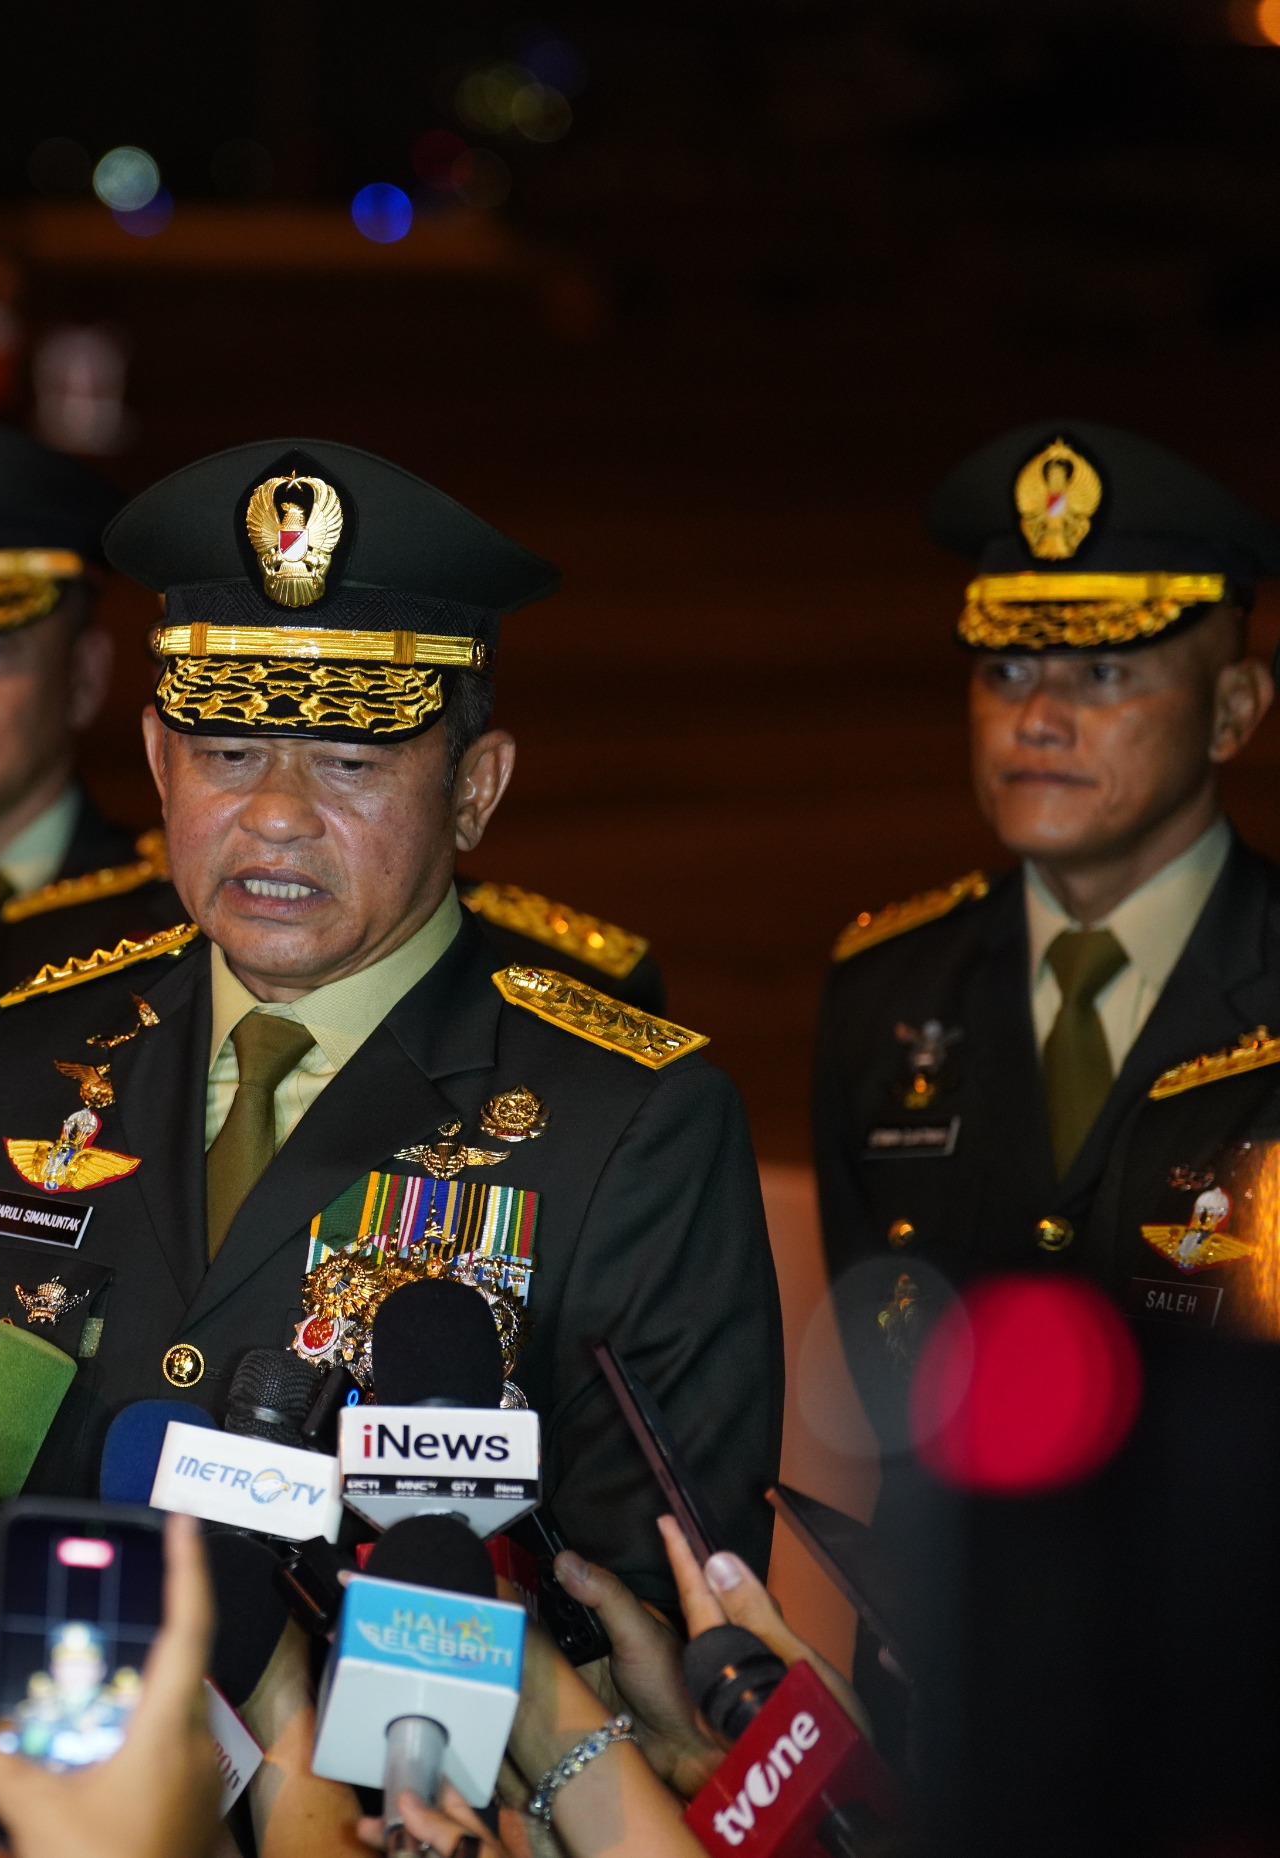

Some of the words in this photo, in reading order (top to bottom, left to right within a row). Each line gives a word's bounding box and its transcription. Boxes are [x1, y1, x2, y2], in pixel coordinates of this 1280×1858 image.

[23, 1209, 81, 1232] SIMANJUNTAK
[1145, 1290, 1197, 1313] SALEH
[363, 1424, 510, 1461] iNews
